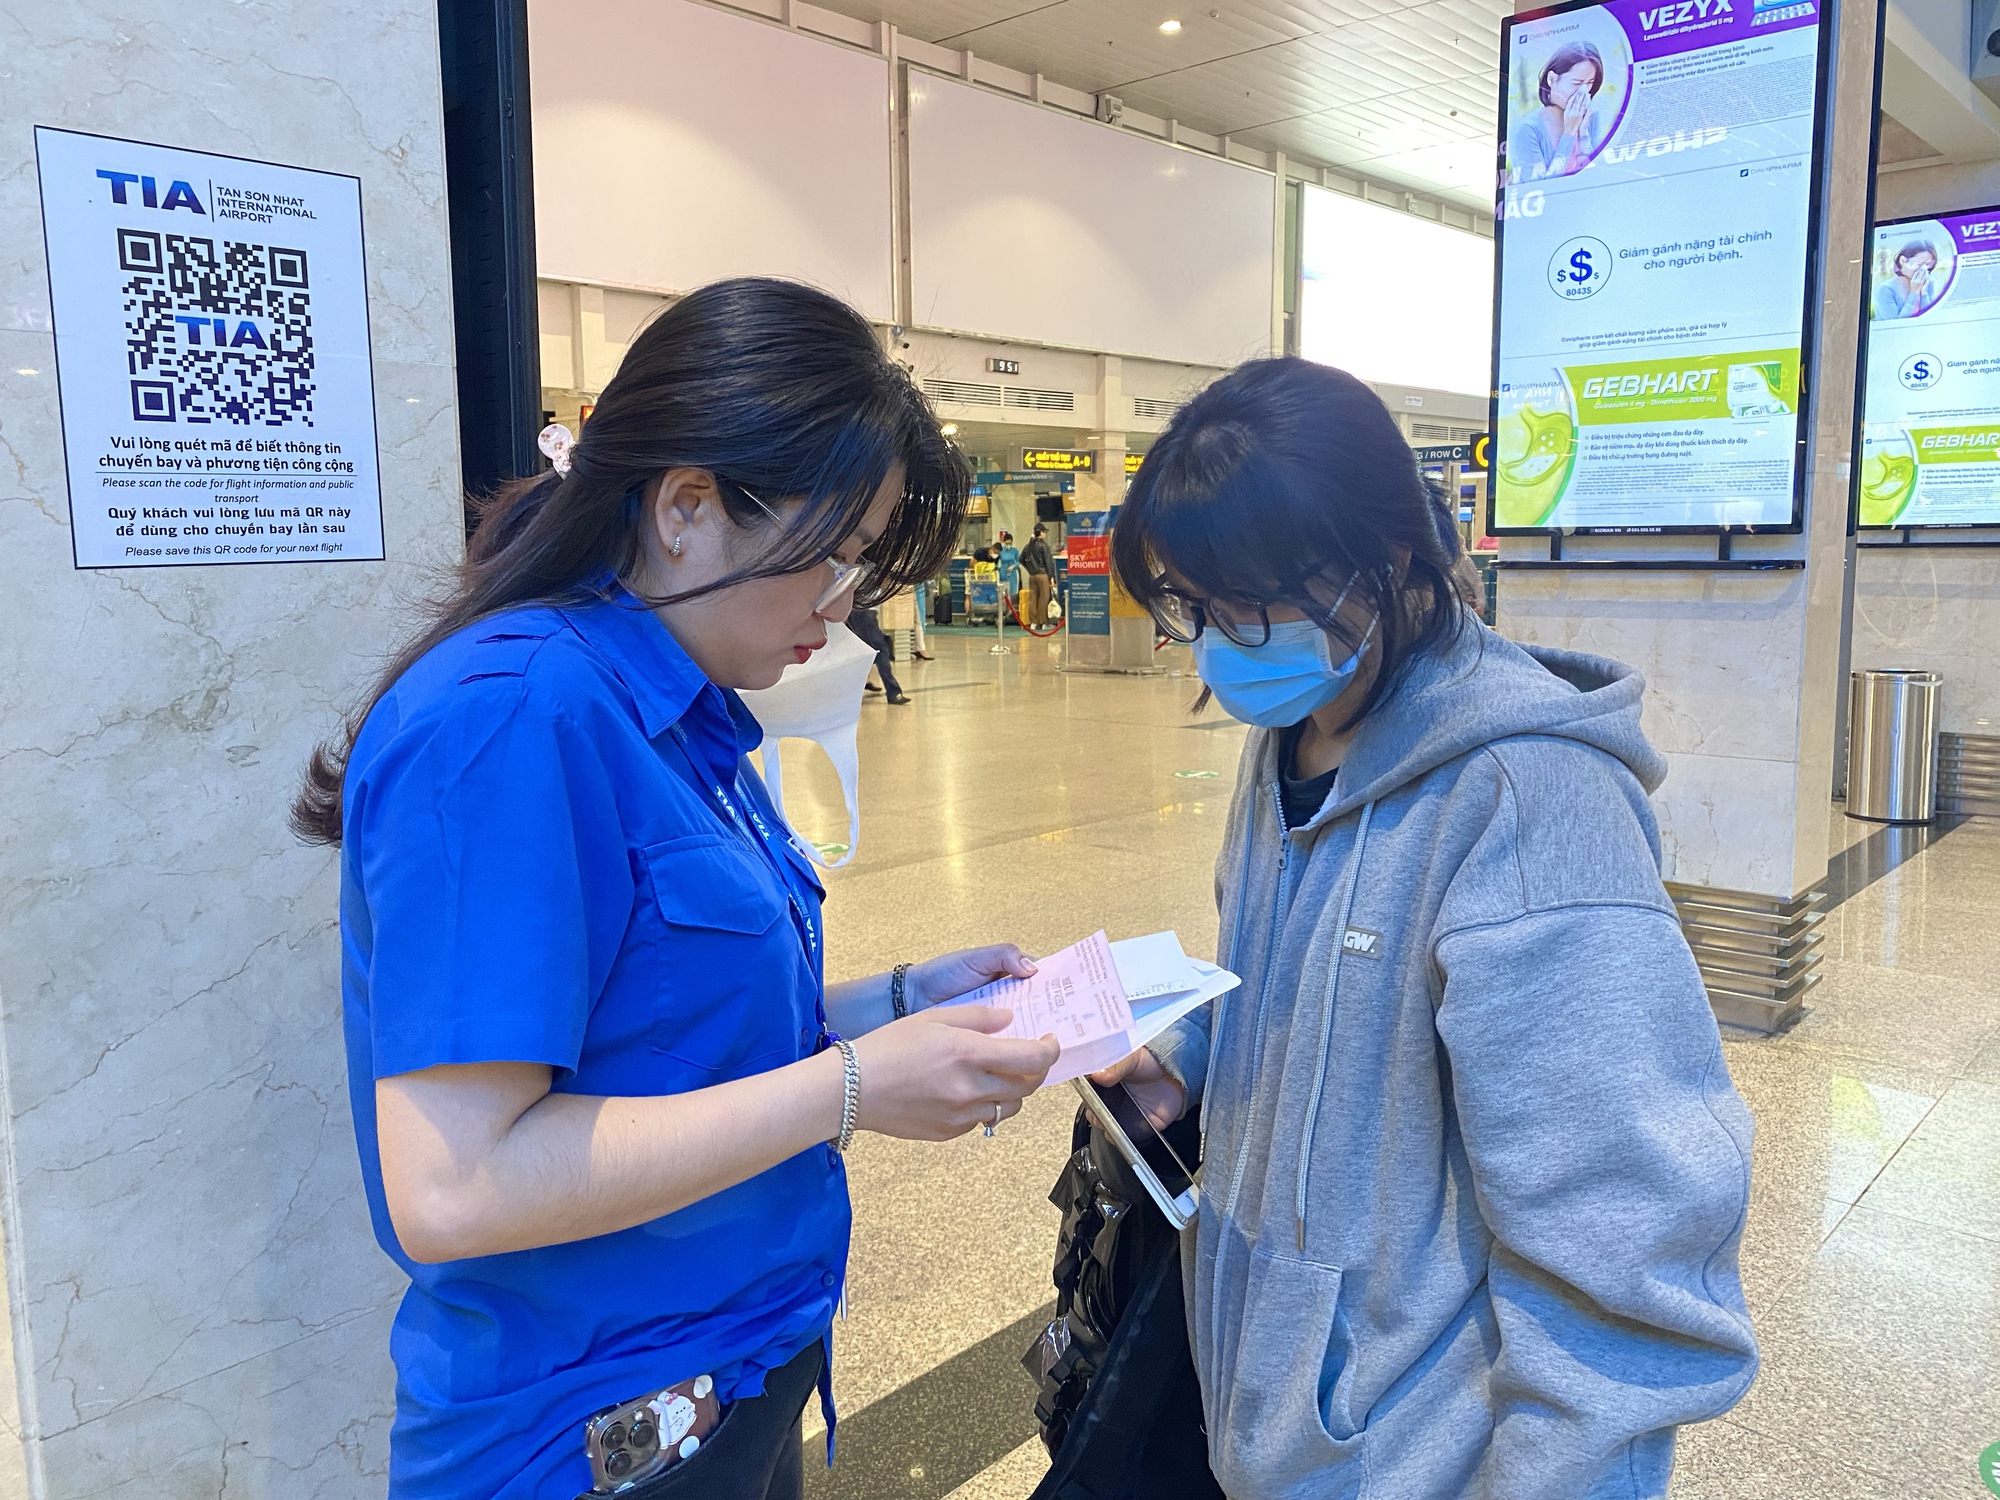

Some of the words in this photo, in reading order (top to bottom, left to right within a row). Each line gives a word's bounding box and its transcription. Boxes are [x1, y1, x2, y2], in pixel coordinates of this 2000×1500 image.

[1638, 0, 1733, 31] VEZYX
[1528, 24, 1580, 40] DAVIPHARM
[1750, 162, 1802, 174] DAVIPHARM
[95, 168, 207, 215] TIA
[216, 186, 241, 198] TAN
[244, 190, 270, 202] SON
[273, 195, 305, 207] NHAT
[217, 197, 317, 219] INTERNATIONAL
[219, 209, 273, 224] AIRPORT
[1619, 247, 1649, 259] Giảm
[1652, 242, 1682, 256] gánh
[1685, 239, 1715, 251] nặng
[1719, 235, 1734, 246] tài
[1737, 230, 1772, 244] chính
[1643, 260, 1666, 270] cho
[1669, 253, 1705, 268] người
[1708, 249, 1743, 263] bệnh.
[175, 315, 269, 351] TIA
[1511, 381, 1561, 391] DAVIPHARM
[1583, 368, 1719, 399] GEBHART
[110, 436, 135, 449] Vui
[139, 436, 171, 452] lòng
[174, 438, 207, 453] quét
[210, 439, 232, 451] mã
[235, 438, 253, 452] để
[256, 439, 282, 453] biết
[285, 441, 322, 456] thông
[324, 442, 341, 454] tin
[1430, 450, 1451, 459] ROW
[1452, 446, 1462, 459] C
[99, 453, 152, 470] chuyến
[156, 455, 182, 470] bay
[185, 456, 202, 468] và
[206, 456, 260, 471] phương
[263, 458, 289, 472] tiện
[292, 458, 322, 472] công
[324, 459, 354, 473] cộng
[102, 477, 136, 488] Please
[138, 480, 162, 488] scan
[165, 478, 181, 488] the
[184, 479, 207, 488] code
[208, 479, 224, 490] for
[225, 479, 251, 490] flight
[253, 479, 307, 490] information
[309, 480, 326, 489] and
[328, 480, 354, 490] public
[214, 494, 259, 504] transport
[108, 507, 137, 520] Quý
[143, 507, 188, 518] khách
[193, 507, 214, 518] vui
[219, 507, 250, 520] lòng
[254, 507, 275, 518] lưu
[280, 507, 300, 518] mã
[305, 507, 323, 517] QR
[329, 507, 351, 519] này
[116, 522, 134, 536] để
[141, 524, 178, 538] dùng
[183, 525, 209, 535] cho
[215, 522, 264, 536] chuyến
[269, 523, 293, 536] bay
[298, 522, 318, 534] lần
[323, 524, 345, 533] sau
[125, 546, 162, 556] Please
[165, 547, 190, 555] save
[193, 545, 211, 555] this
[214, 545, 231, 554] QR
[233, 545, 257, 554] code
[260, 544, 274, 553] for
[275, 545, 297, 554] your
[299, 543, 319, 552] next
[320, 543, 343, 553] flight
[1069, 554, 1085, 562] SKY
[1069, 561, 1106, 569] PRIORITY
[716, 785, 735, 819] TIA
